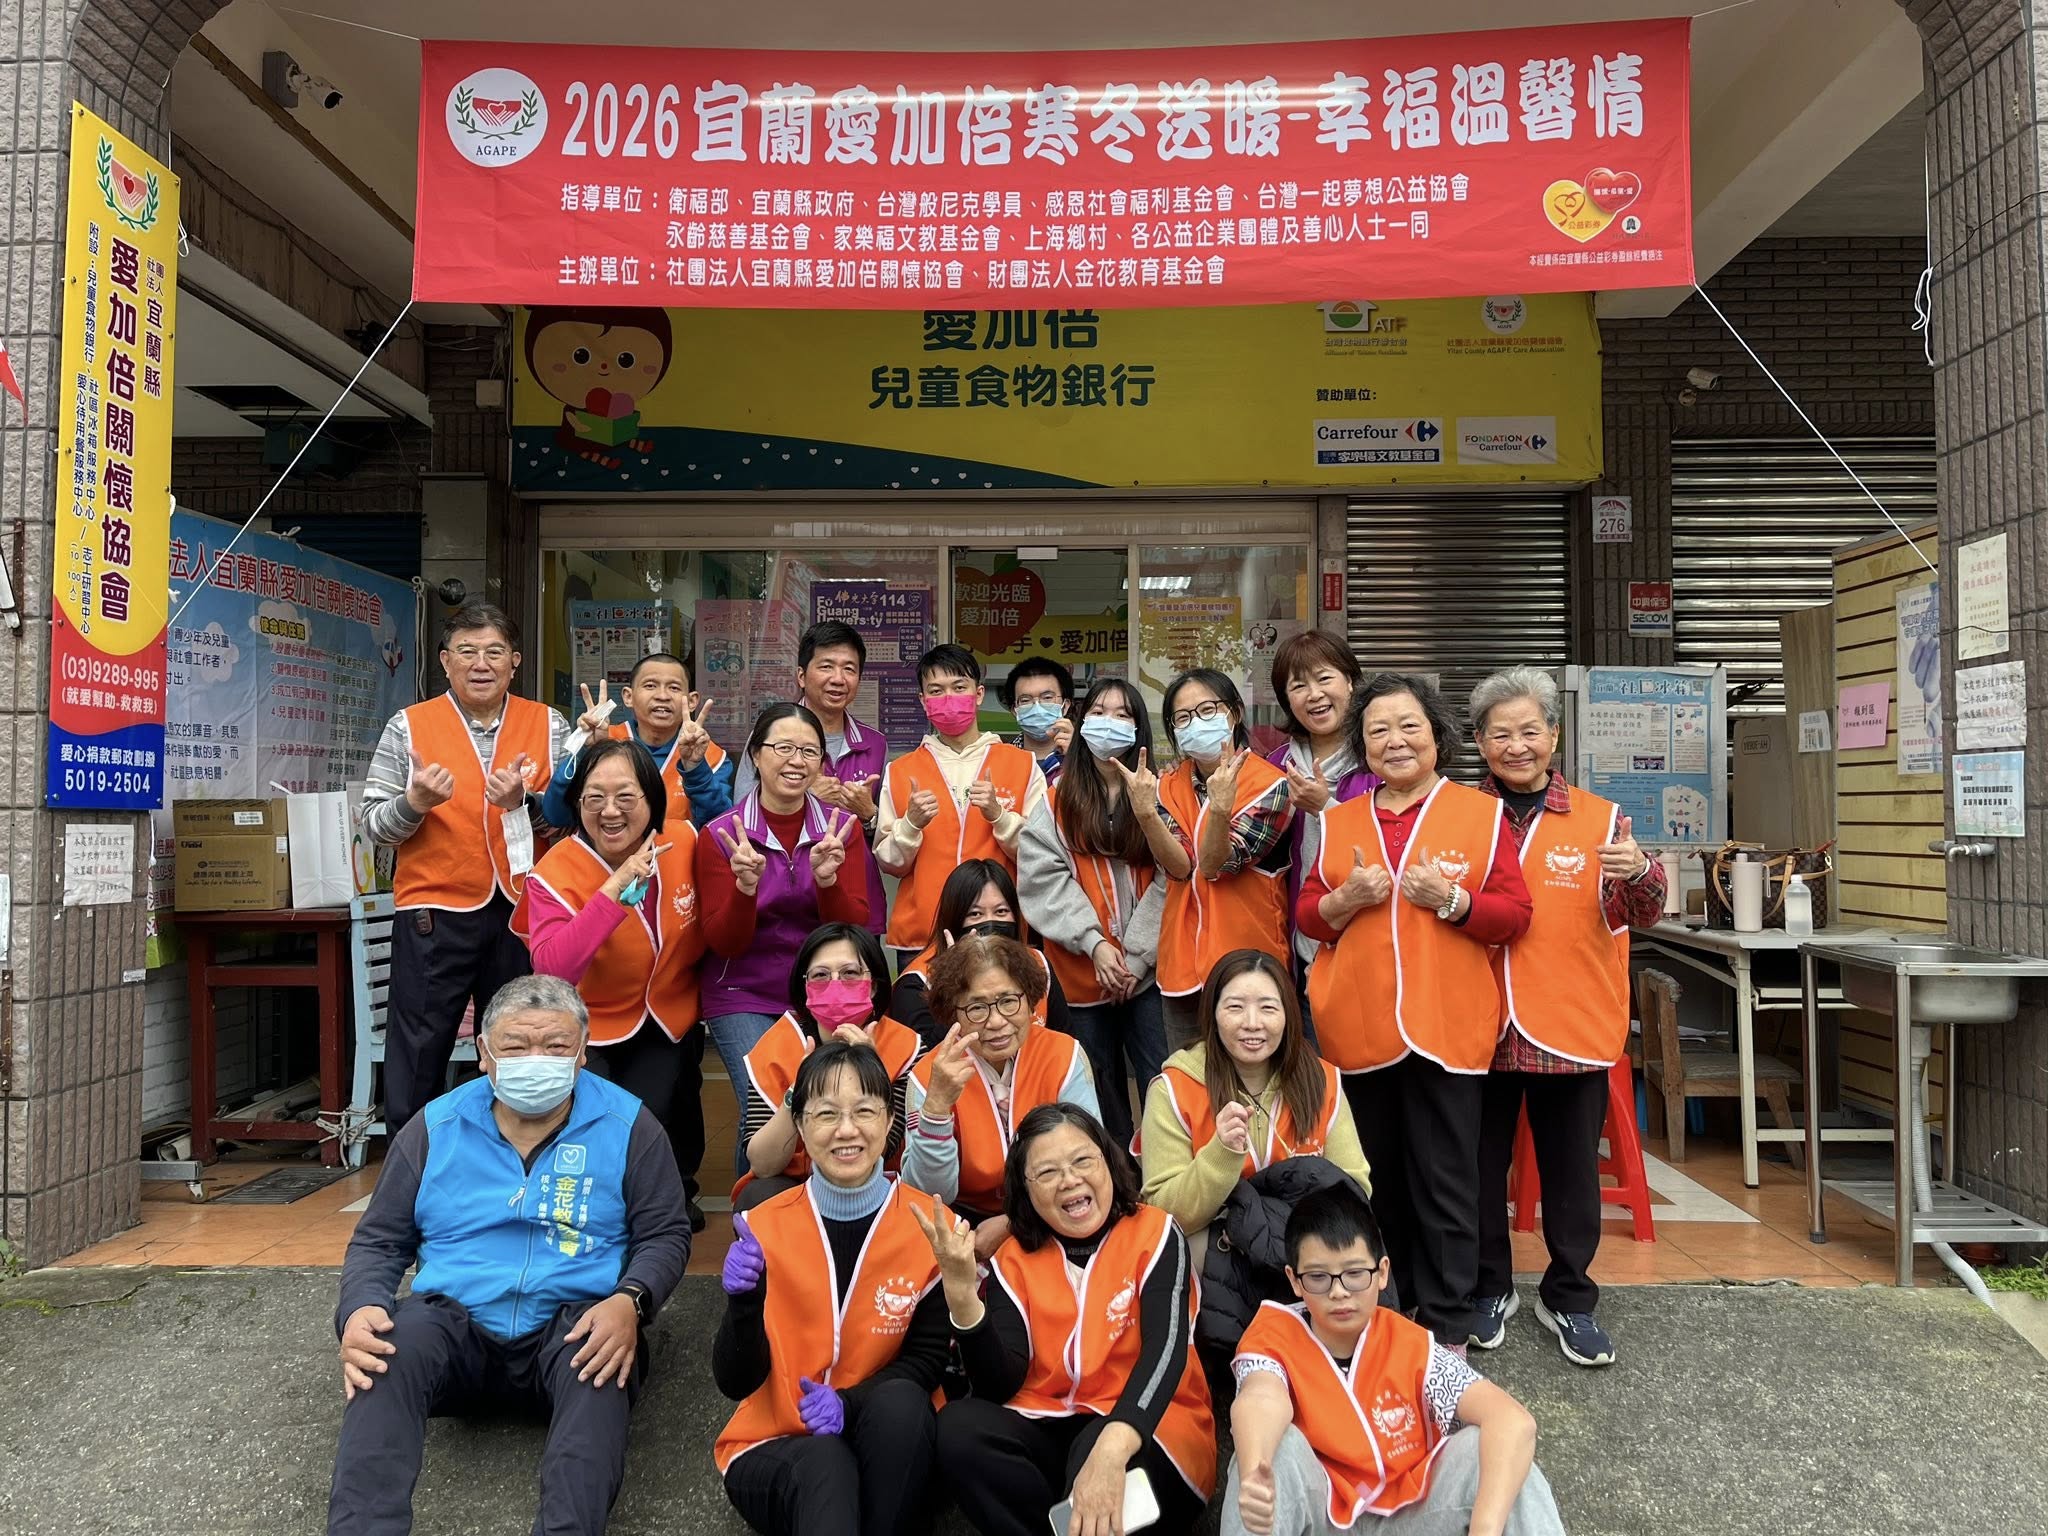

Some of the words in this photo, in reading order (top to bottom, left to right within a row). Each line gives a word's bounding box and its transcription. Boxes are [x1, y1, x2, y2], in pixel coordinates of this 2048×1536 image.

[476, 145, 517, 157] AGAPE
[923, 309, 1100, 351] 愛加倍
[1373, 316, 1408, 332] ATF
[143, 299, 164, 399] 宜蘭縣
[1487, 346, 1511, 354] AGAPE
[868, 363, 1156, 410] 兒童食物銀行
[100, 236, 140, 623] 愛加倍關懷協會
[1317, 424, 1399, 440] Carrefour
[1465, 434, 1523, 444] FONDATION
[1479, 442, 1523, 452] Carrefour
[1599, 518, 1626, 533] 276
[816, 595, 833, 607] Fo
[880, 593, 906, 607] 114
[816, 605, 860, 619] Guang
[960, 606, 1021, 627] 愛加倍
[1633, 613, 1669, 623] SECOM
[61, 651, 160, 691] (03)9289-995
[60, 744, 156, 769] 愛心捐款郵政劃撥
[64, 768, 151, 795] 5019-2504
